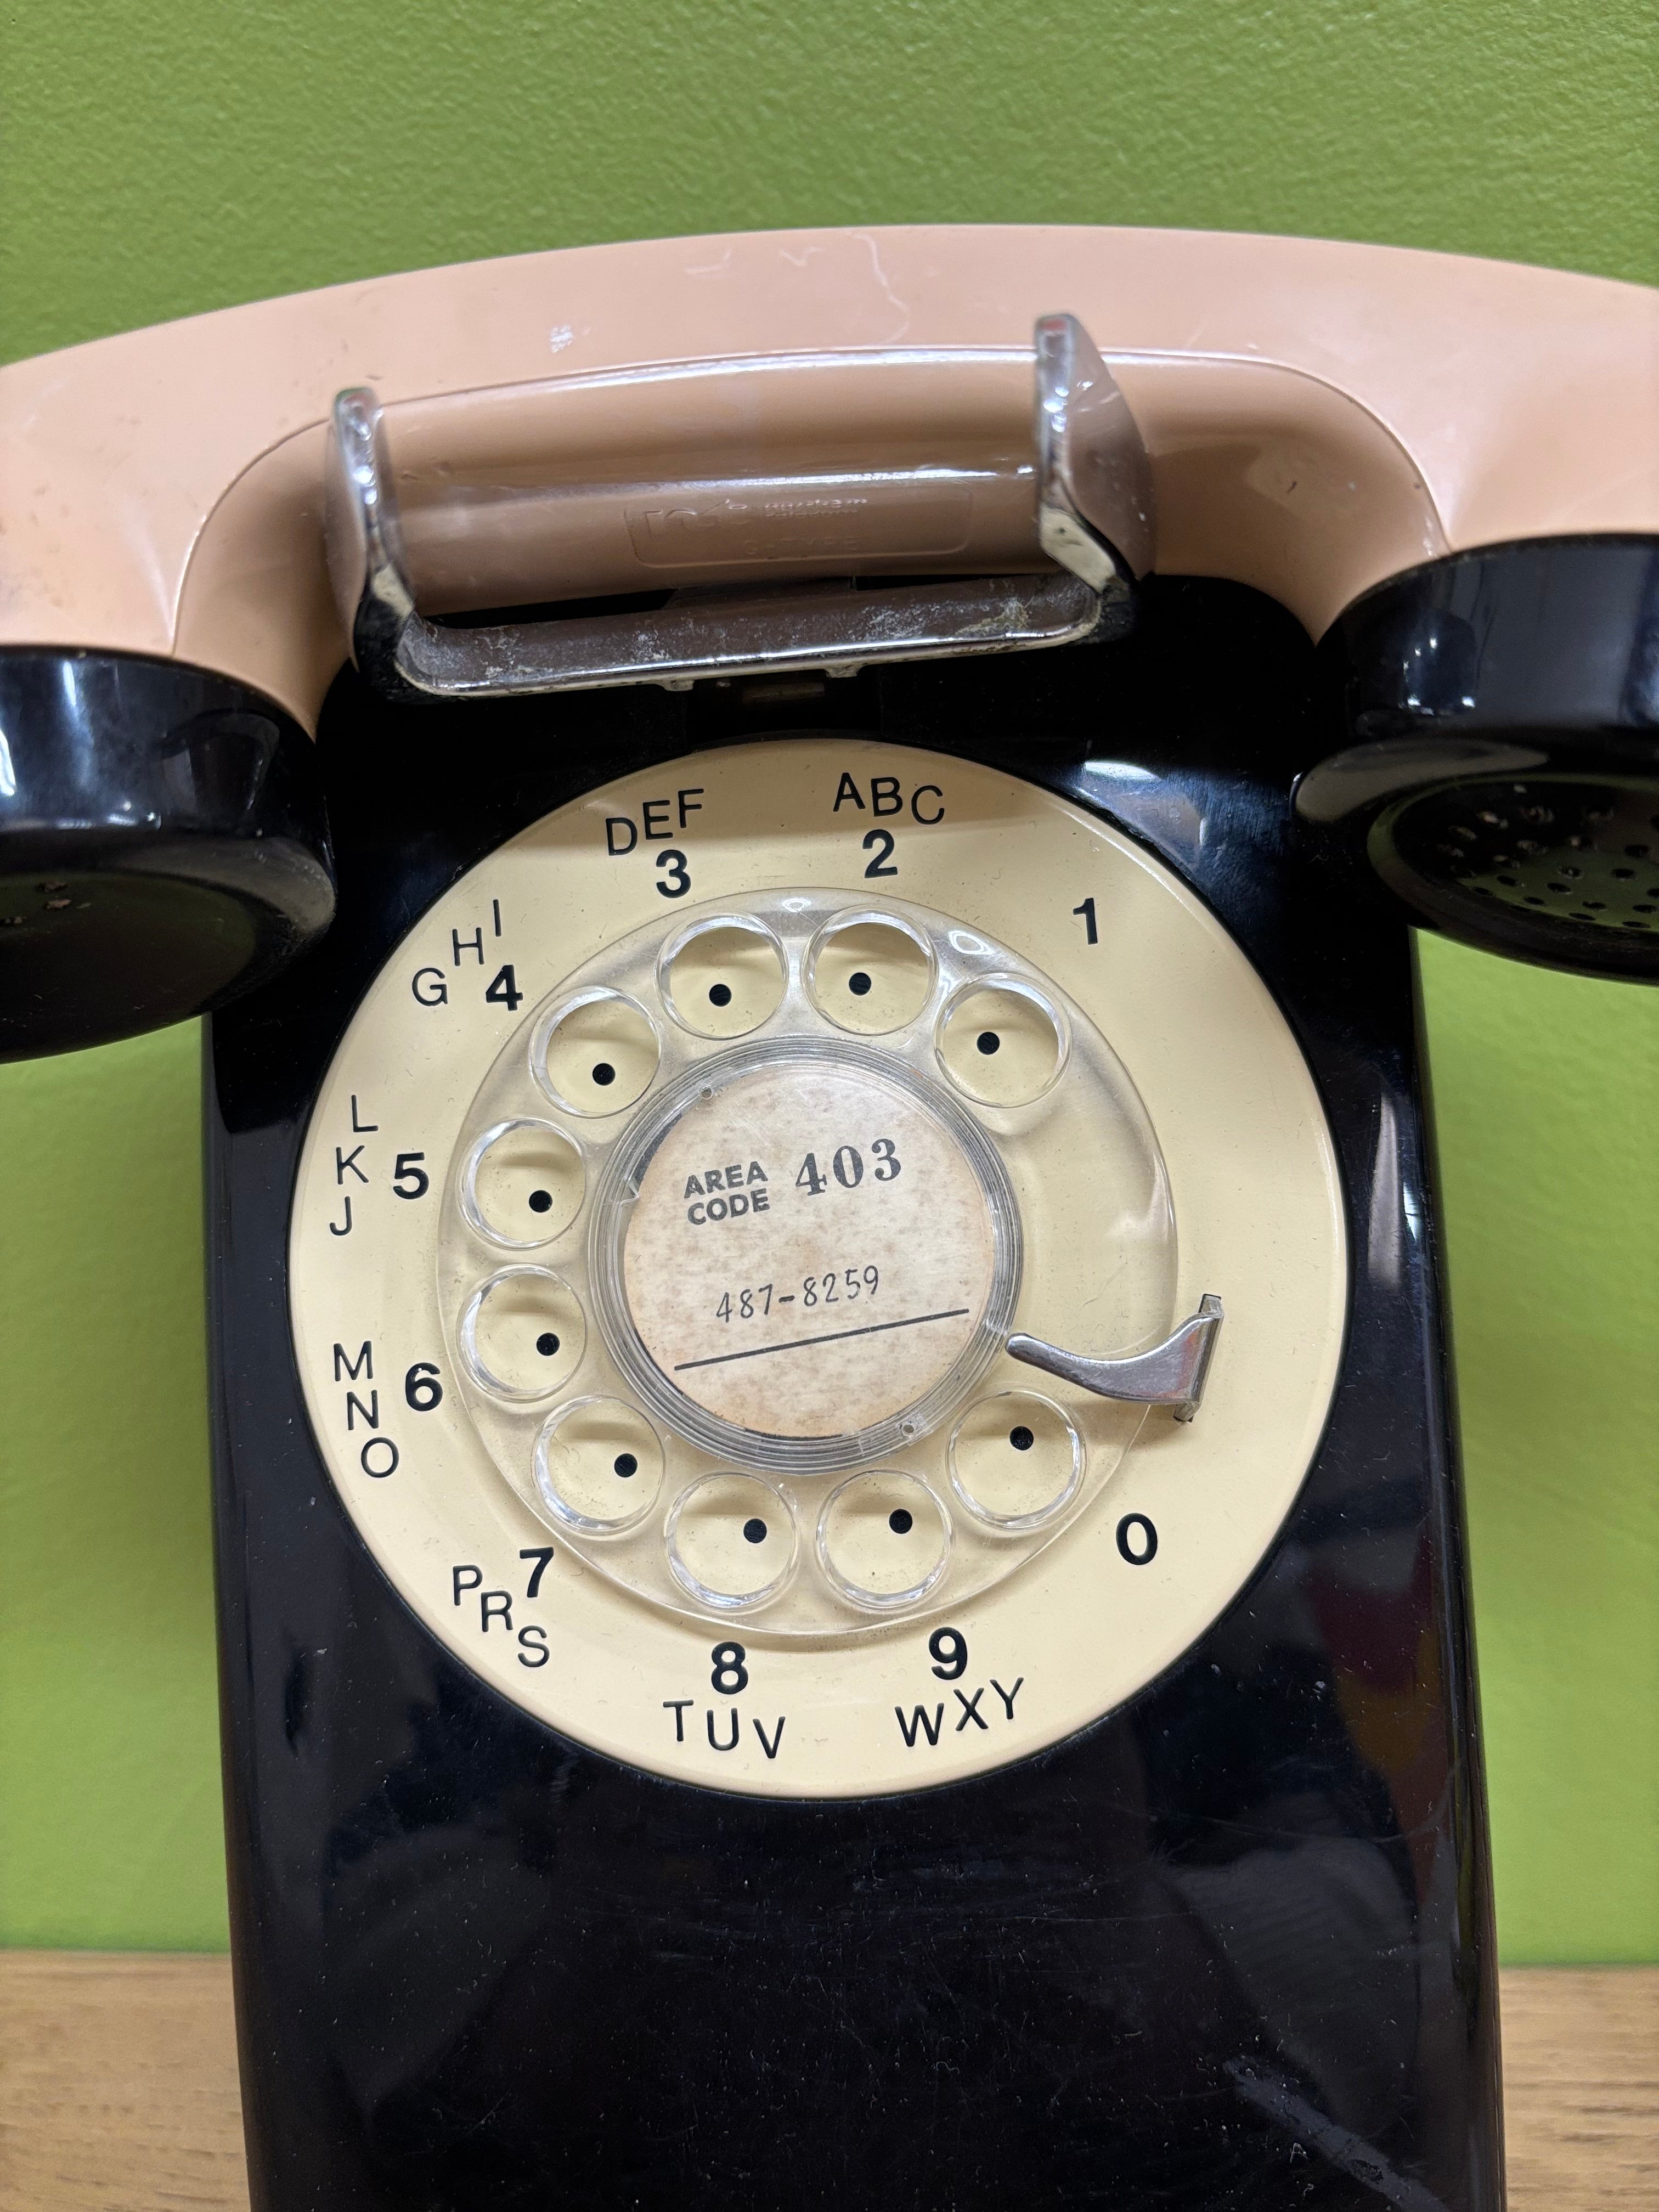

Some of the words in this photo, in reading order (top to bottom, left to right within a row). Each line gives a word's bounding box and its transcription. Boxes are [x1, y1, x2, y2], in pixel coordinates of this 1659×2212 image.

[605, 788, 704, 856] DEF
[833, 771, 945, 825] ABC
[656, 849, 691, 899] 3
[862, 828, 898, 879] 2
[1073, 898, 1098, 945] 1
[485, 964, 523, 1012] 4
[393, 1152, 429, 1200] 5
[684, 1161, 768, 1199] AREA
[795, 1138, 901, 1196] 403
[687, 1188, 770, 1225] CODE
[715, 1265, 879, 1323] 487-8259
[405, 1362, 443, 1412] 6
[1116, 1513, 1158, 1566] 0
[520, 1547, 554, 1598] 7
[711, 1641, 748, 1695] 8
[928, 1627, 968, 1680] 9
[663, 1700, 786, 1759] TUV
[894, 1677, 1024, 1747] WXY
